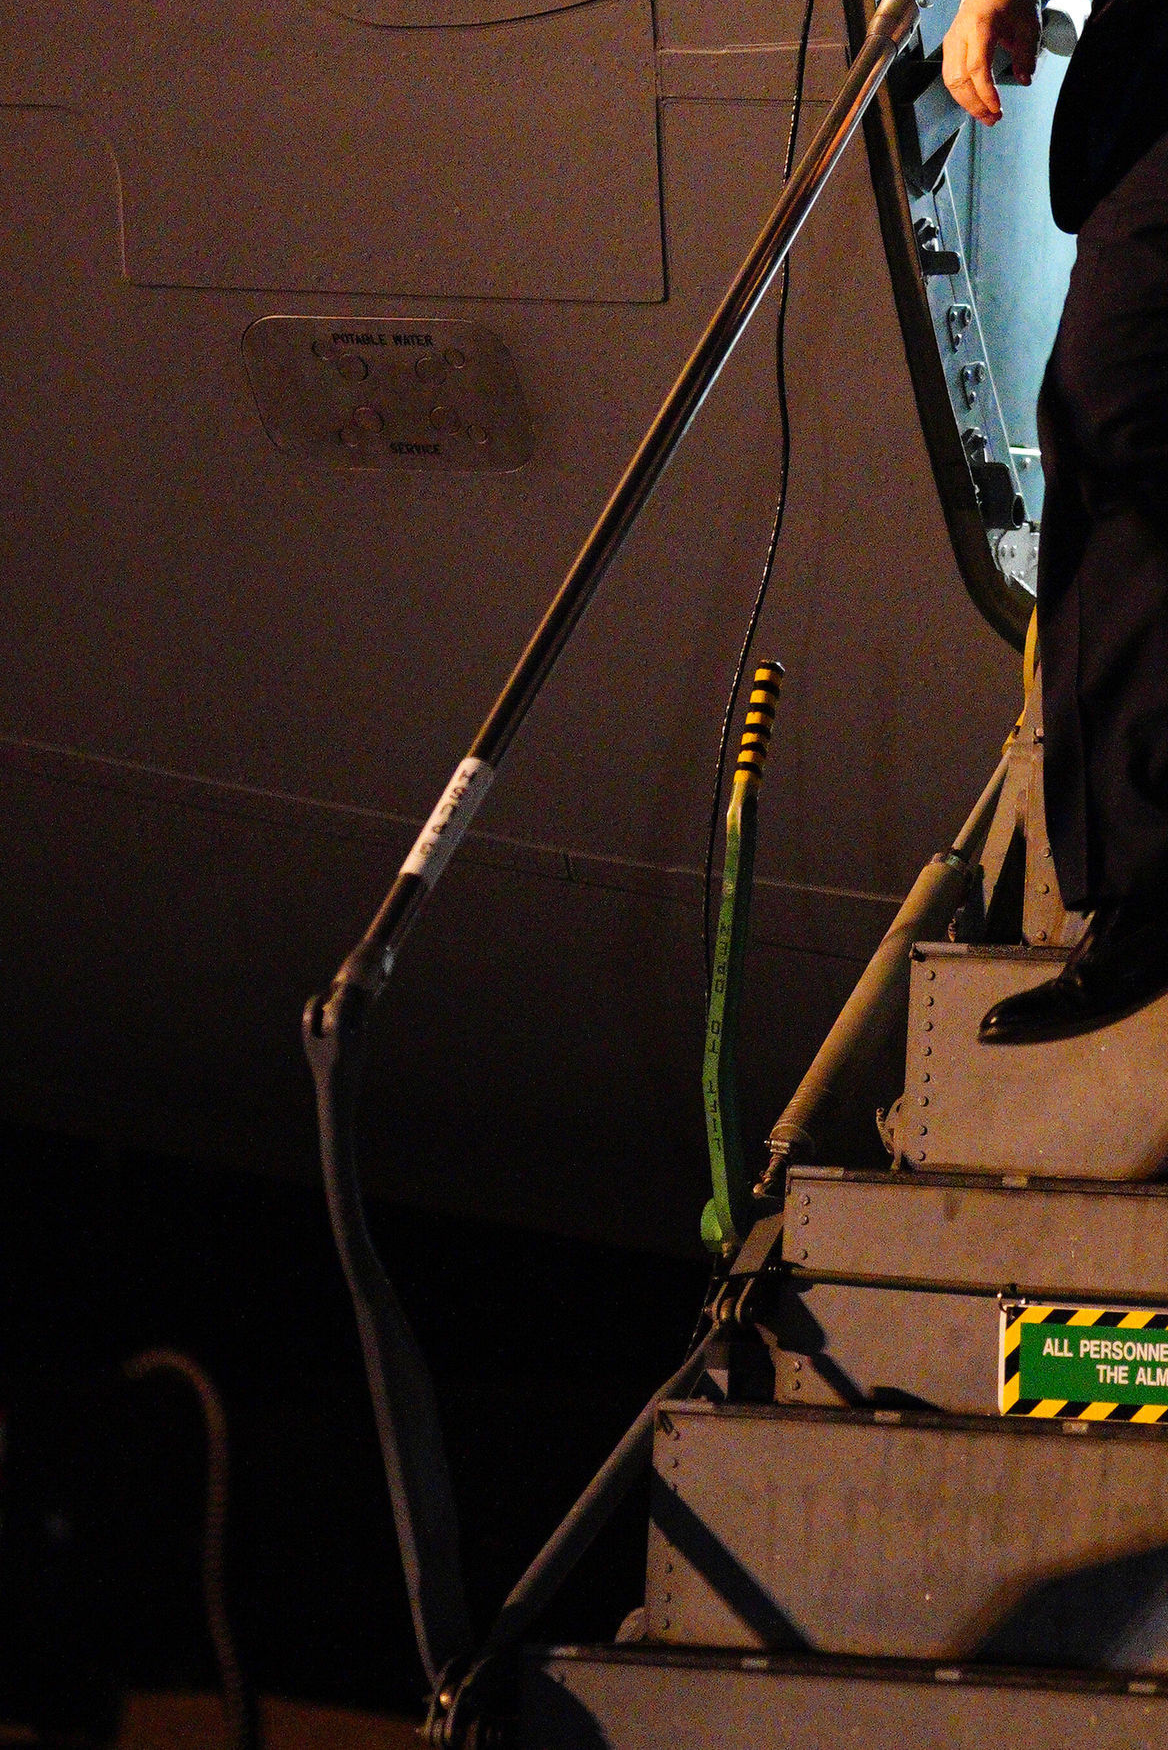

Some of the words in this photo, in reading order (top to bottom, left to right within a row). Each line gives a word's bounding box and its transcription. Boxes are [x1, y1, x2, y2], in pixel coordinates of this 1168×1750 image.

[332, 333, 387, 346] POTABLE
[392, 334, 434, 347] WATER
[389, 442, 442, 455] SERVICE
[1042, 1337, 1074, 1358] ALL
[1096, 1364, 1129, 1385] THE
